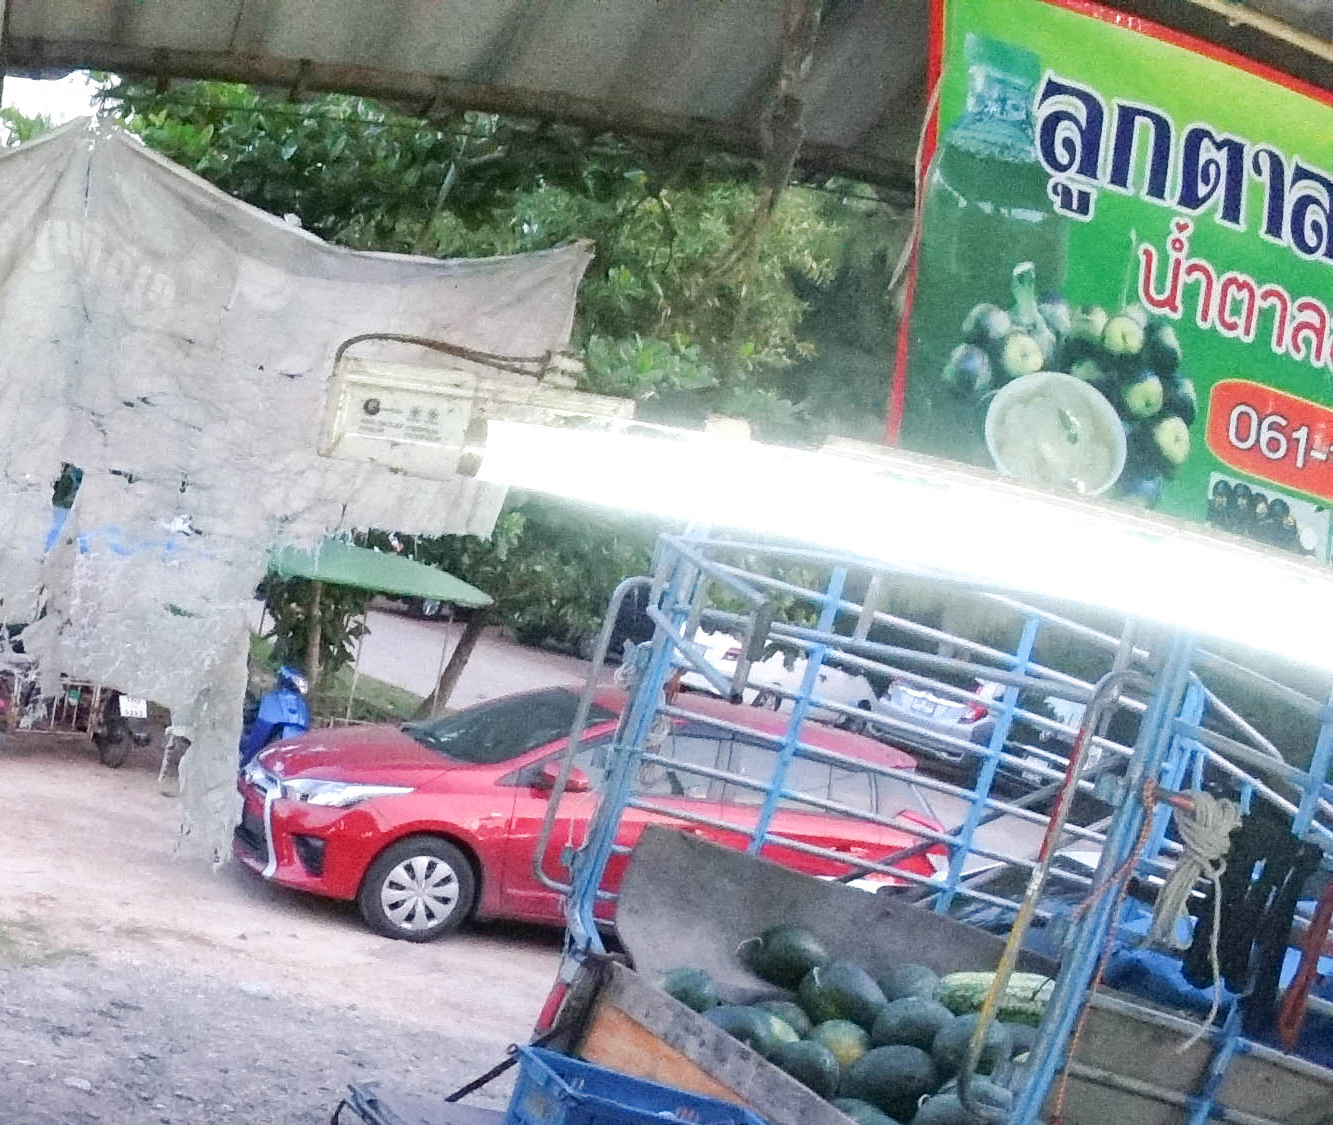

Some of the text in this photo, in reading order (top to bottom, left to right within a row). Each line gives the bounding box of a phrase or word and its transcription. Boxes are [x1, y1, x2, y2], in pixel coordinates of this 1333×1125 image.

[1037, 73, 1333, 264] ลูกตาล
[1139, 219, 1333, 368] น้ำตาล
[1228, 403, 1333, 469] 061-
